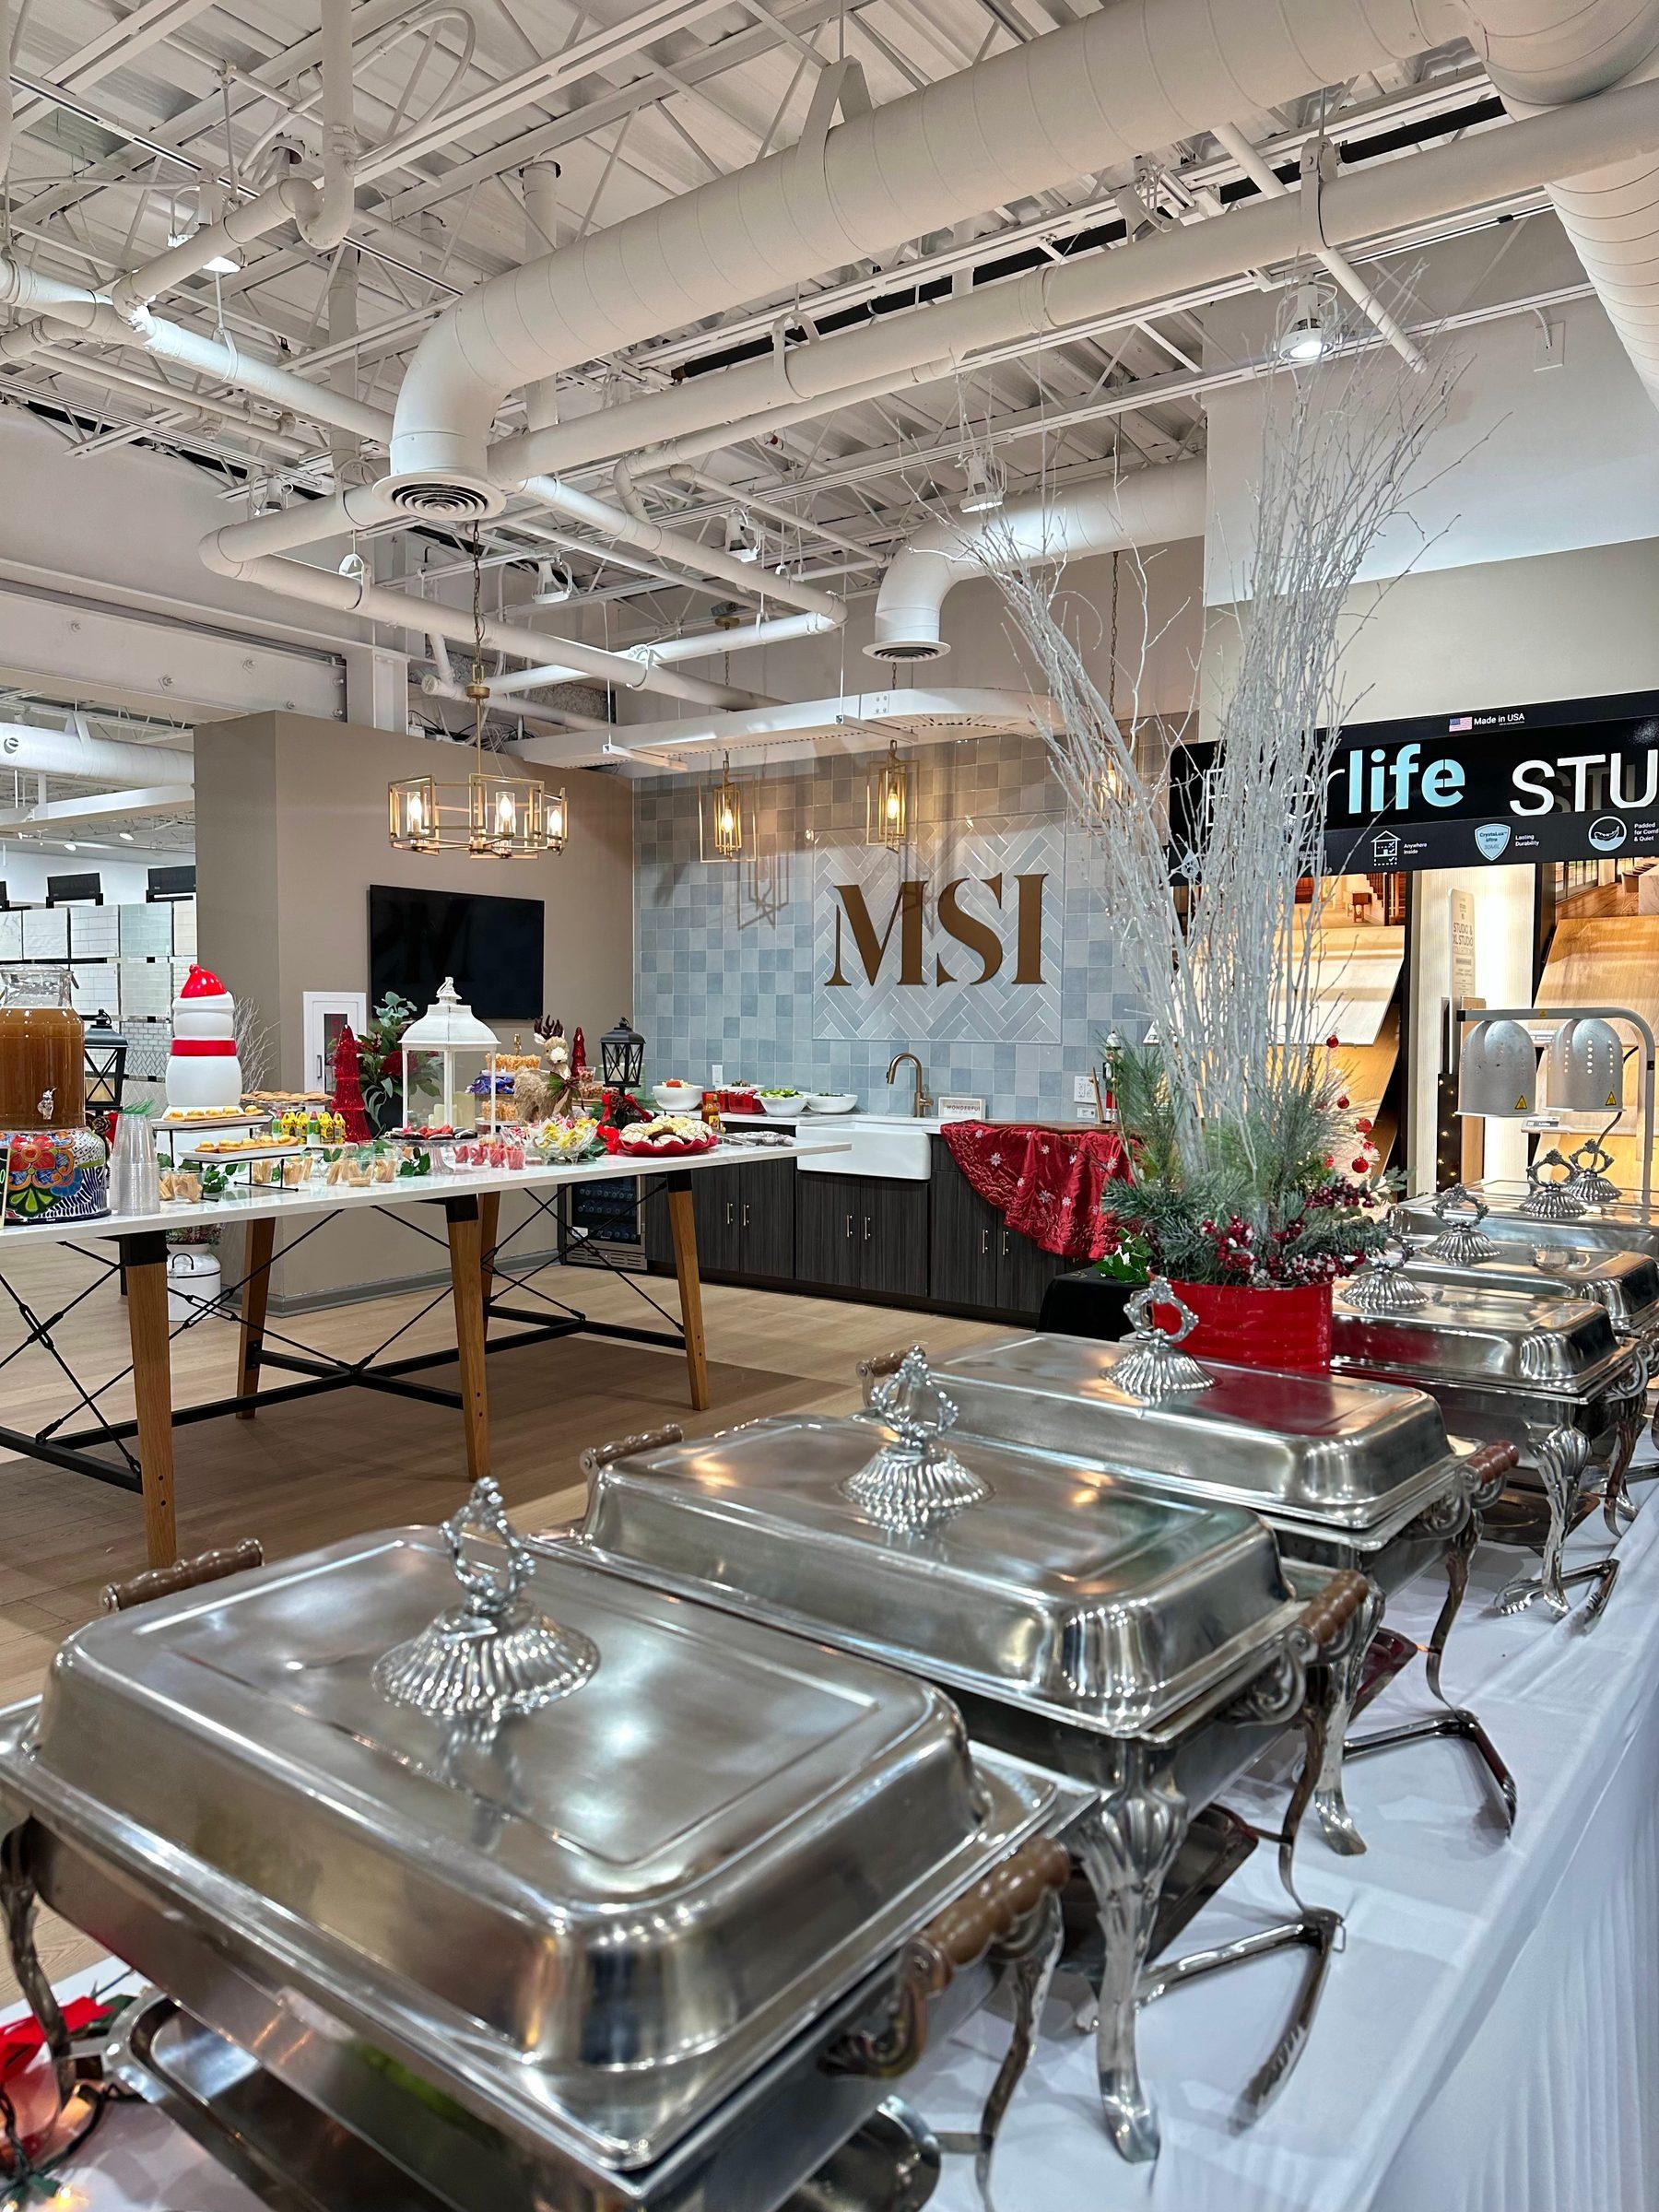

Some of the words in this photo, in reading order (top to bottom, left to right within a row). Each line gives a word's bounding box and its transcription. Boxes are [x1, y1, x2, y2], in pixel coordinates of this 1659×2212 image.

[1474, 717, 1497, 725] Made
[1507, 712, 1525, 722] USA
[1205, 743, 1465, 827] Eerlife
[1509, 748, 1659, 817] STU
[824, 872, 1049, 987] MSI
